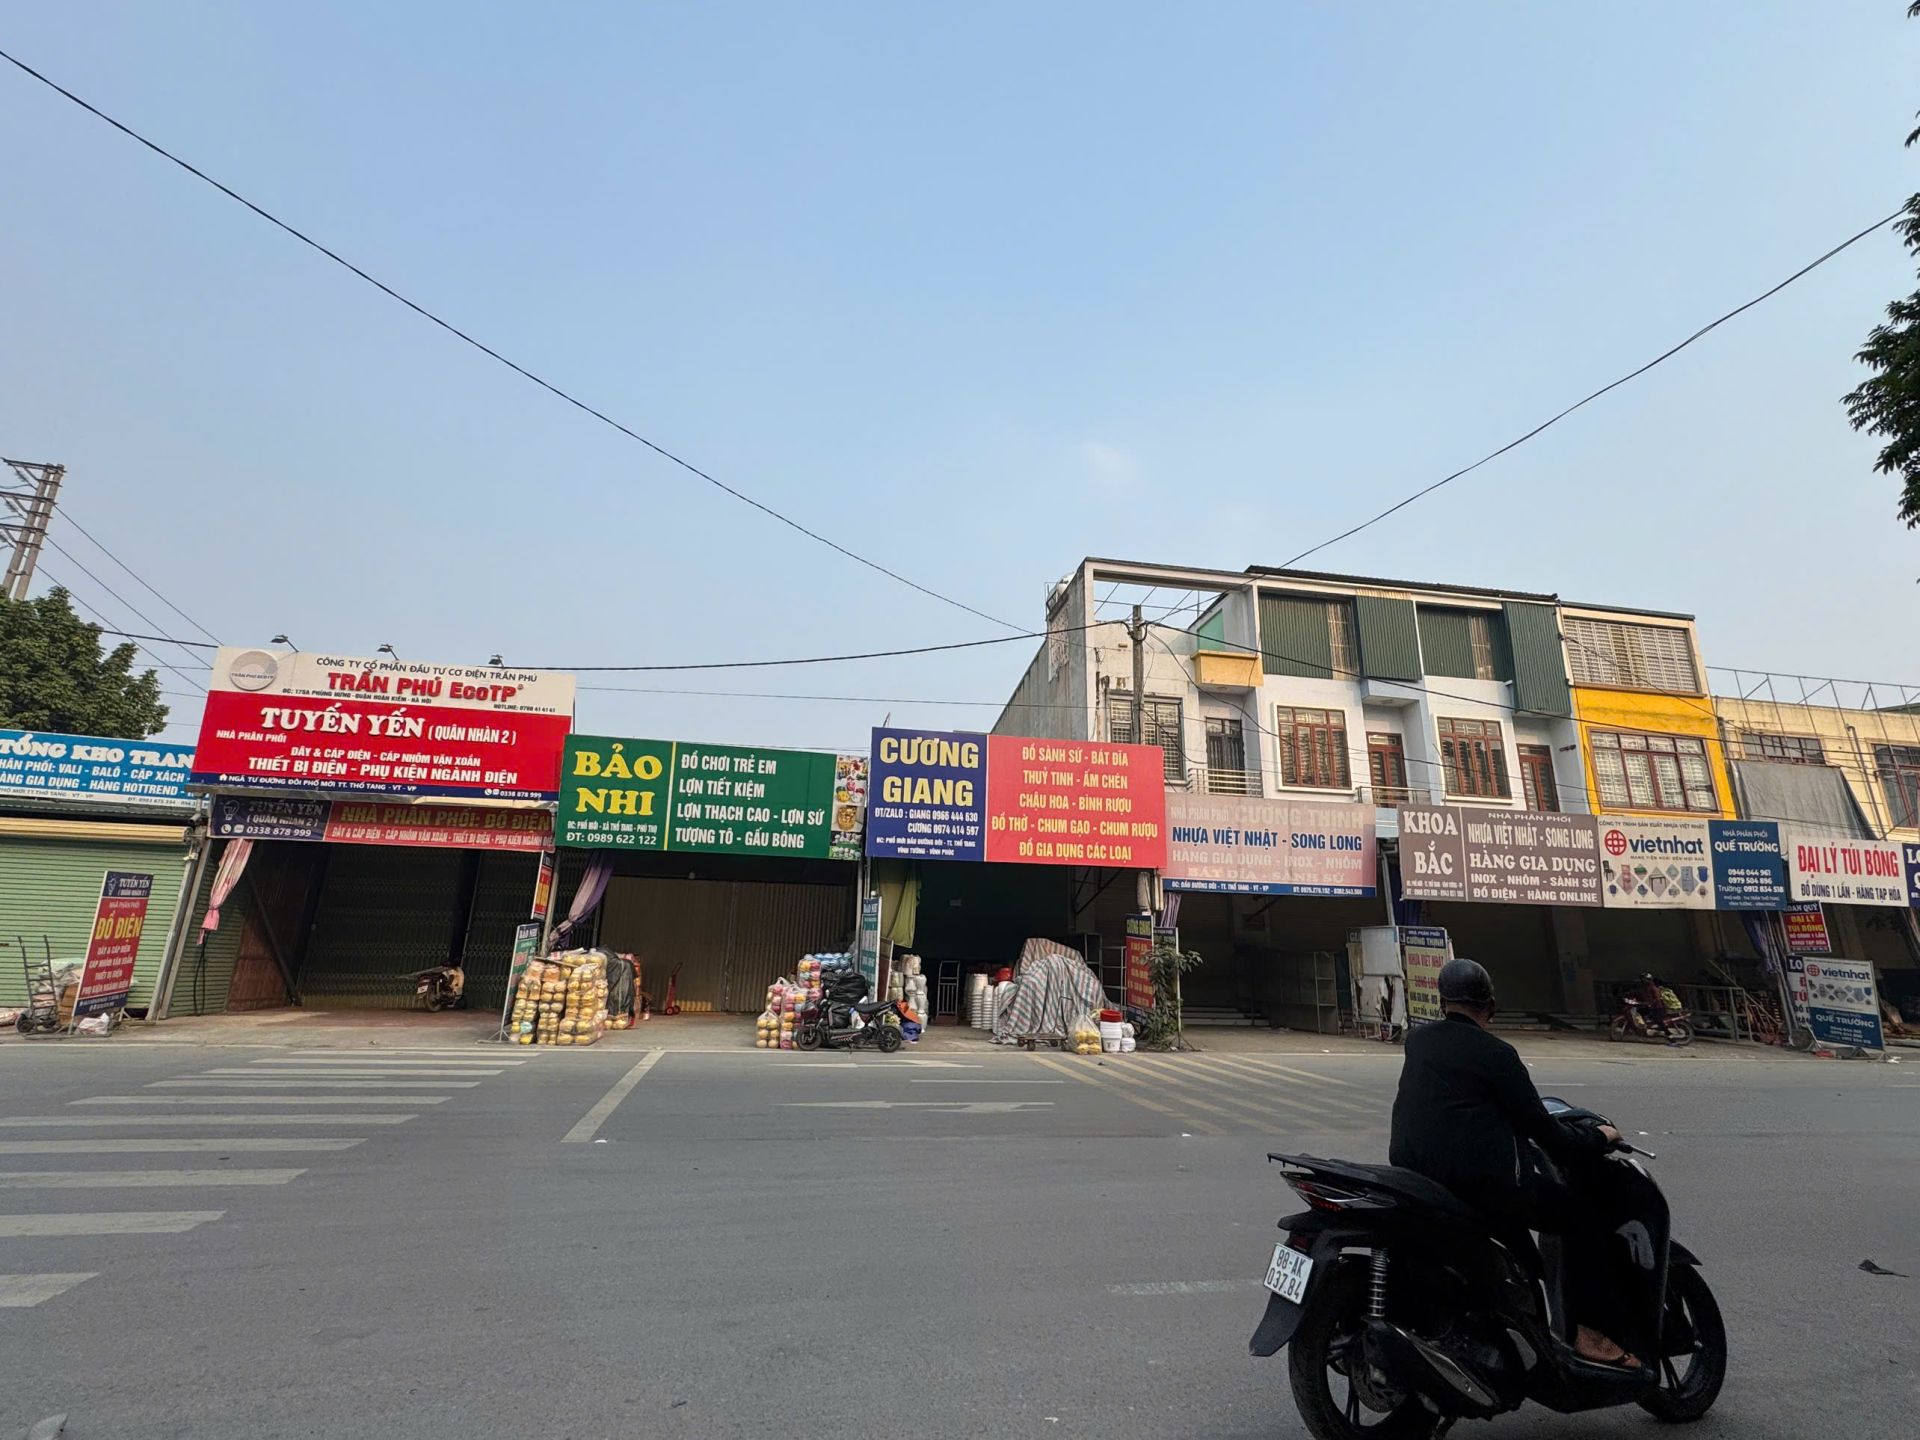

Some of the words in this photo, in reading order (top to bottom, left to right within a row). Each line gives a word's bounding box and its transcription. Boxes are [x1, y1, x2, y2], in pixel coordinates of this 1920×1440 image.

[316, 657, 344, 667] CÔNG
[349, 660, 362, 668] TY
[364, 658, 378, 670] CỔ
[433, 666, 446, 675] TƯ
[465, 669, 487, 679] ĐIỆN
[518, 672, 538, 682] PHÚ
[396, 677, 443, 697] PHÚ
[261, 702, 362, 734] TUYẾN
[367, 707, 425, 738] YẾN
[468, 726, 500, 744] NHÀN
[216, 730, 236, 739] NHÀ
[238, 731, 263, 742] PHÂN
[265, 732, 287, 742] PHỐI
[71, 744, 124, 762] KHO
[290, 746, 312, 756] DÂY
[324, 748, 345, 759] CÁP
[347, 749, 370, 760] ĐIỆN
[380, 751, 400, 762] CÁP
[573, 743, 662, 780] BẢO
[701, 754, 730, 772] CHƠI
[732, 752, 756, 774] TRẺ
[758, 760, 776, 774] EM
[880, 737, 979, 769] CƯỜNG
[1038, 745, 1066, 762] SÀNH
[1069, 748, 1082, 764] SỨ
[1092, 748, 1110, 766] BÁT
[1111, 751, 1128, 767] ĐĨA
[58, 764, 82, 775] VALI
[92, 765, 120, 778] BALÔ
[130, 769, 151, 782] CẶP
[155, 770, 184, 783] XÁCH
[248, 755, 290, 772] THIẾT
[294, 760, 308, 775] BỊ
[312, 758, 347, 775] ĐIỆN
[360, 764, 390, 780] PHỤ
[394, 764, 427, 781] KIỆN
[430, 766, 480, 782] NGÀNH
[484, 769, 518, 786] ĐIỆN
[1051, 772, 1074, 786] TINH
[1083, 770, 1100, 788] ẤM
[1102, 773, 1128, 789] CHÉN
[26, 775, 48, 786] GIA
[49, 776, 80, 790] DỤNG
[89, 780, 120, 792] HÀNG
[122, 782, 178, 796] HOTTREND
[303, 778, 319, 786] PHỐ
[320, 778, 336, 787] MỚI
[679, 778, 704, 796] LỢN
[707, 778, 734, 796] TIẾT
[734, 780, 764, 801] KIỆM
[883, 776, 973, 806] GIANG
[575, 787, 656, 816] NHI
[1019, 792, 1046, 810] CHẬU
[1049, 795, 1069, 810] HOA
[1078, 794, 1103, 812] BÌNH
[1105, 797, 1132, 814] RƯỢU
[342, 804, 377, 822] NHÀ
[383, 806, 431, 825] PHÂN
[677, 803, 702, 820] LỢN
[704, 804, 744, 822] THẠCH
[747, 807, 770, 822] CAO
[781, 809, 806, 828] LỢN
[808, 808, 825, 826] SỨ
[909, 809, 930, 820] GIANG
[951, 812, 964, 822] 444
[966, 812, 978, 822] 630
[1404, 811, 1458, 836] KHOA
[1488, 812, 1511, 820] NHÀ
[1514, 814, 1544, 822] PHÂN
[246, 826, 270, 834] 0338
[272, 827, 292, 836] 878
[294, 828, 312, 838] 999
[676, 827, 716, 846] TƯỢNG
[719, 826, 734, 844] TÔ
[744, 829, 770, 846] GẤU
[772, 830, 804, 848] BÔNG
[908, 822, 932, 834] CƯỜNG
[934, 824, 950, 834] 0974
[952, 826, 965, 836] 414
[966, 826, 980, 836] 597
[1008, 815, 1028, 832] THỜ
[1038, 818, 1068, 834] CHUM
[1070, 820, 1090, 836] GẠO
[1099, 820, 1130, 836] CHUM
[1132, 822, 1158, 840] RƯỢU
[1172, 826, 1208, 847] NHỰA
[1212, 826, 1240, 848] VIỆT
[1244, 828, 1278, 850] NHẬT
[1291, 833, 1326, 850] SONG
[1330, 835, 1362, 850] LONG
[1467, 822, 1493, 848] NHỰA
[1494, 821, 1512, 850] VIỆT
[1515, 824, 1538, 850] NHẬT
[1546, 827, 1570, 848] SONG
[1571, 828, 1594, 849] LONG
[587, 833, 614, 843] 0989
[616, 834, 635, 844] 622
[638, 835, 656, 845] 122
[1629, 834, 1704, 854] vietnhat
[1714, 838, 1736, 852] QUẾ
[1738, 840, 1778, 852] TRƯỜNG
[1036, 843, 1052, 858] GIA
[1056, 844, 1084, 862] DỤNG
[1086, 843, 1107, 859] CÁC
[1110, 846, 1132, 860] LOẠI
[1212, 852, 1234, 865] GIA
[1284, 855, 1312, 868] INOX
[1414, 840, 1452, 875] BẮC
[1470, 850, 1516, 870] HÀNG
[1520, 856, 1548, 872] GIA
[1552, 857, 1596, 876] DỤNG
[1798, 844, 1820, 879] ĐẠI
[1824, 842, 1838, 874] LÝ
[1841, 842, 1862, 876] TÚI
[1471, 873, 1496, 884] INOX
[1507, 874, 1540, 886] NHÔM
[1550, 875, 1579, 888] SÀNH
[1582, 876, 1597, 889] SỨ
[1492, 887, 1517, 900] ĐIỆN
[1528, 888, 1557, 900] HÀNG
[1559, 892, 1598, 902] ONLINE
[1832, 886, 1836, 898] 1
[1856, 884, 1874, 900] HÀNG
[1876, 887, 1888, 904] TẠP
[114, 914, 143, 942] ĐIỆN
[1821, 968, 1871, 980] vietnhat
[1276, 1249, 1306, 1278] 88-AK
[1266, 1267, 1302, 1300] 037.84
